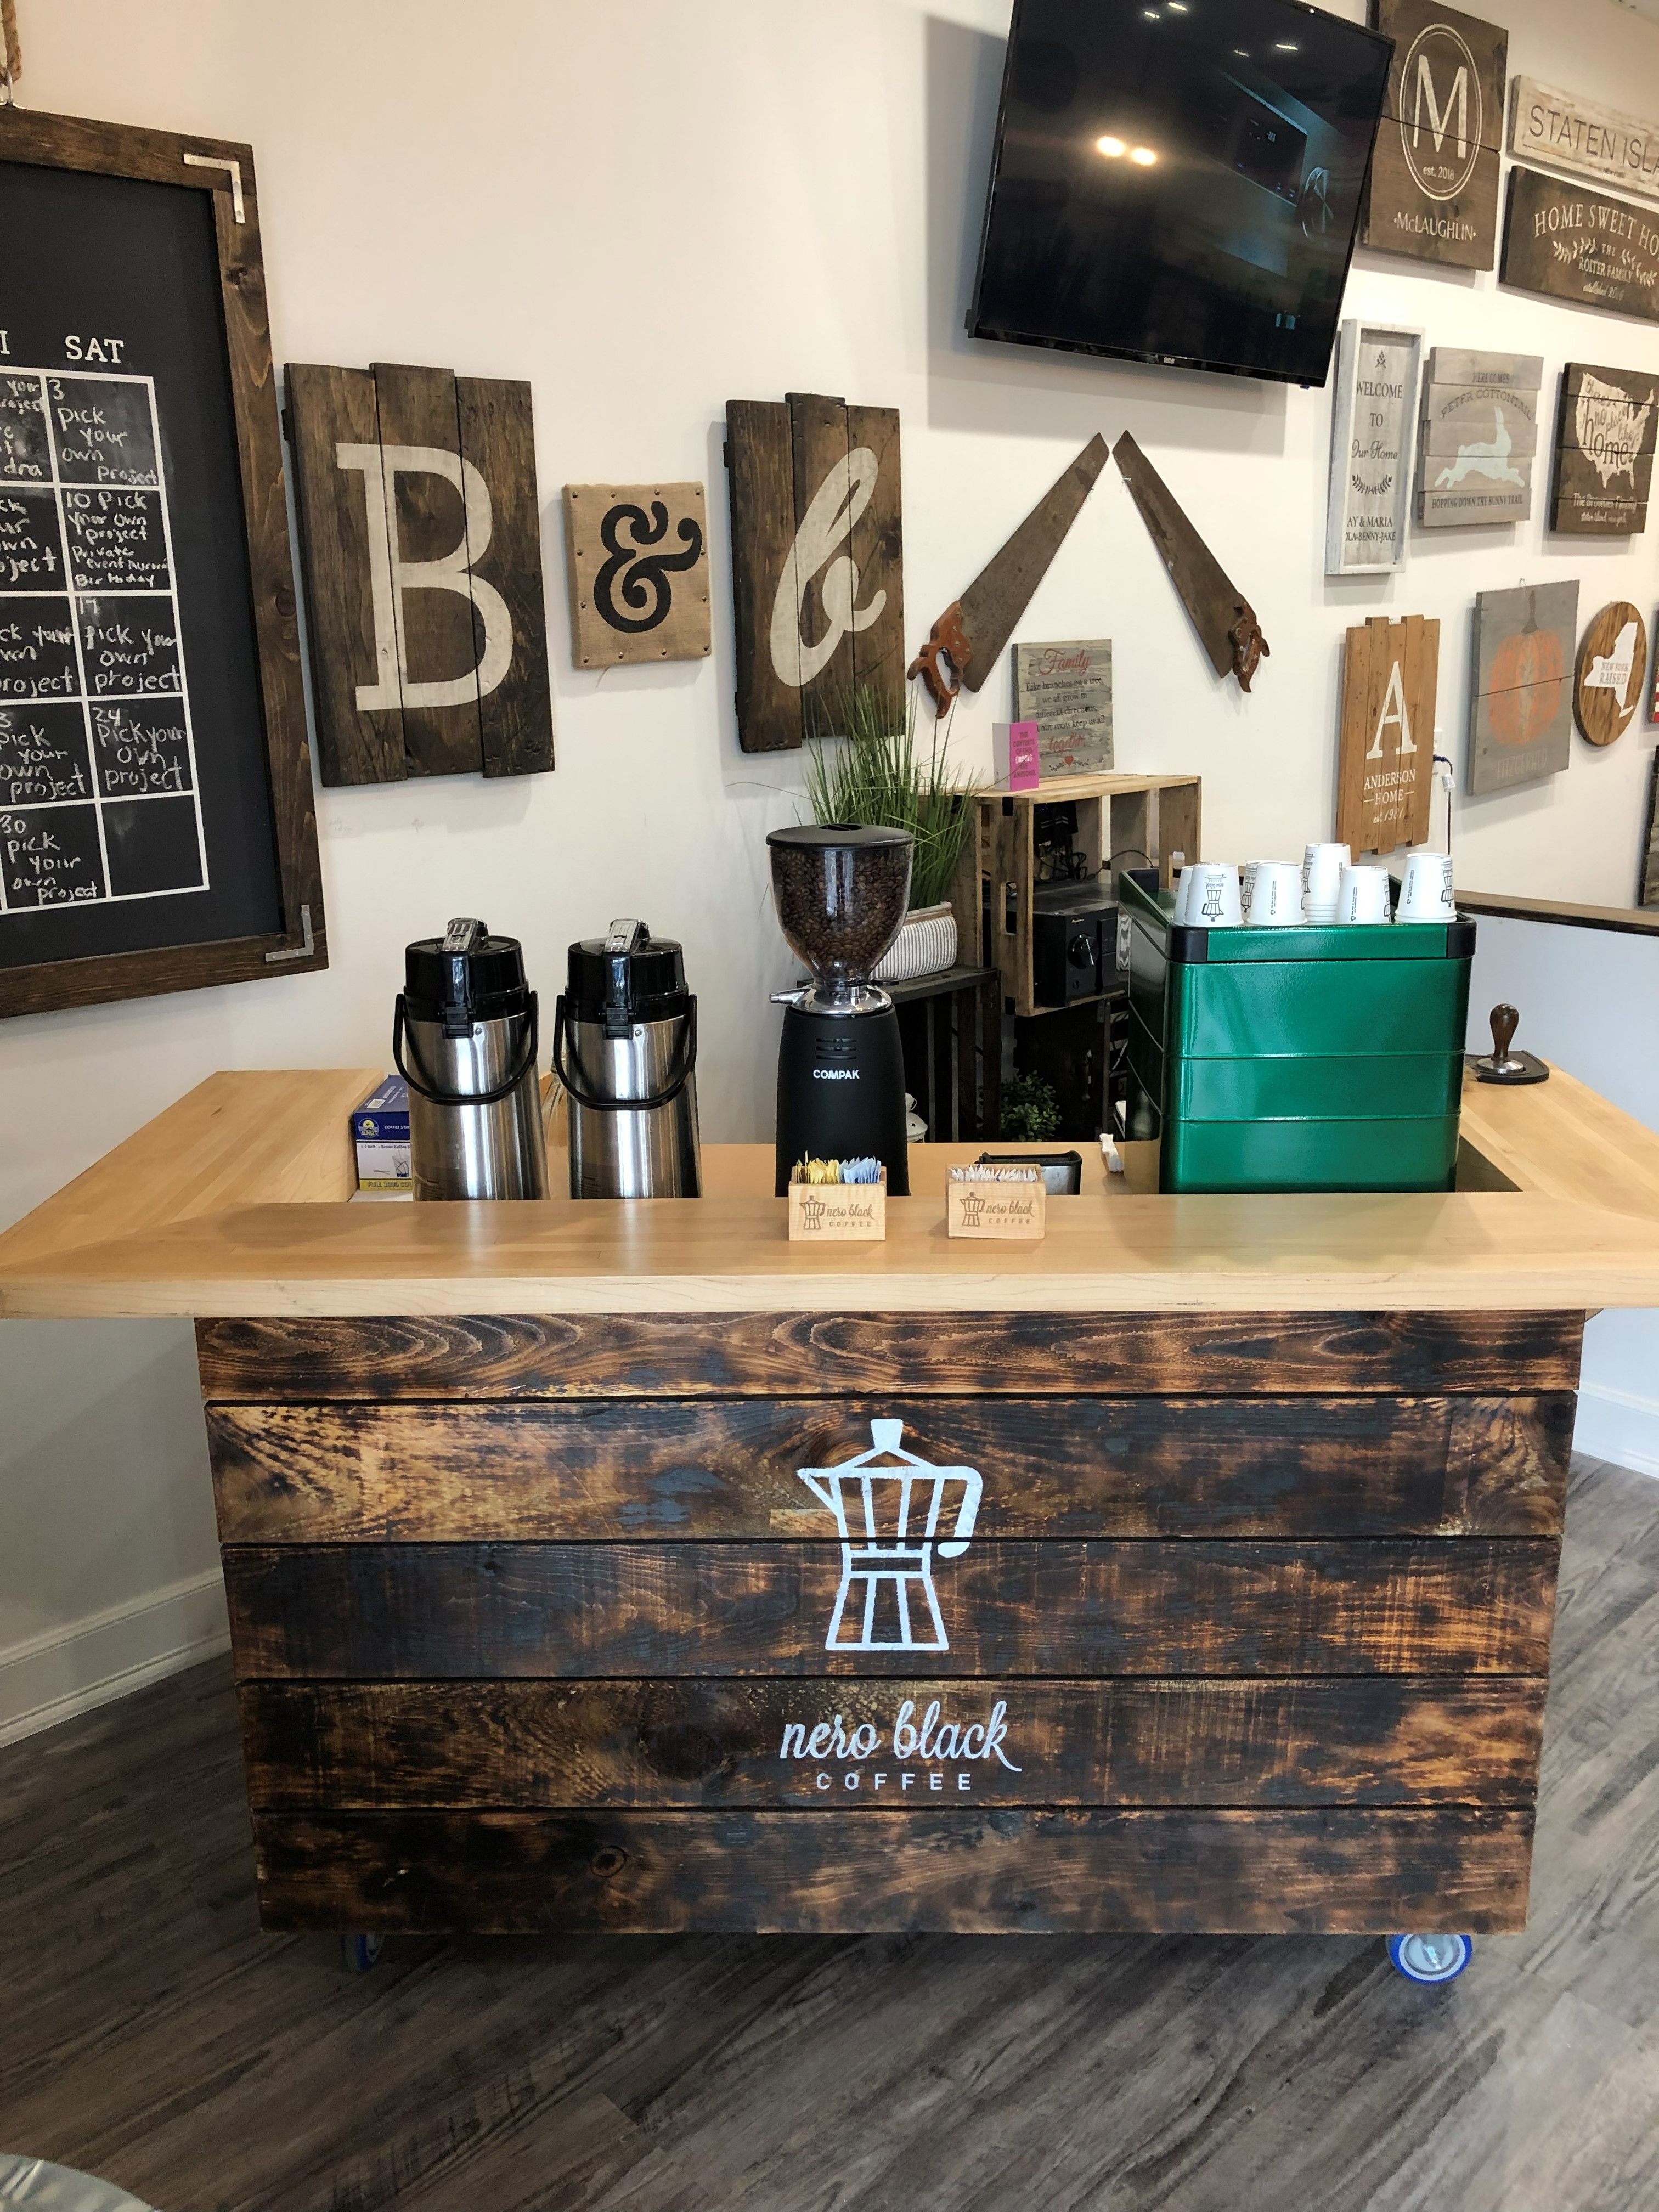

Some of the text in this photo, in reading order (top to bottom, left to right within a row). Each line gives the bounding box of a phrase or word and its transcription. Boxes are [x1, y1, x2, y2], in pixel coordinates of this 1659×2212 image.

[1413, 54, 1468, 159] M
[1530, 105, 1616, 161] STATEN
[1423, 166, 1455, 180] est. 2018
[1534, 204, 1584, 238] HOME
[1588, 205, 1637, 240] SWEET
[1602, 243, 1616, 257] THE
[1606, 264, 1633, 283] FAMILY
[65, 335, 124, 363] SAT
[49, 379, 65, 400] 3
[1356, 381, 1403, 399] WELCOME
[1370, 413, 1384, 427] TO
[79, 427, 128, 447] your
[61, 447, 104, 462] own
[1370, 441, 1398, 460] Home
[66, 491, 91, 509] 10
[1432, 498, 1458, 509] HOPPING
[1458, 497, 1476, 508] DOWN
[1477, 496, 1488, 506] THE
[1508, 494, 1523, 505] TRAIL
[1359, 516, 1365, 527] &
[1367, 516, 1392, 527] MARIA
[86, 526, 147, 546] project
[86, 556, 124, 569] event
[593, 500, 703, 634] &
[335, 442, 513, 712] B
[79, 596, 98, 614] 17
[99, 650, 148, 667] own
[1038, 648, 1091, 676] Family
[95, 664, 181, 695] project
[1026, 682, 1041, 692] Like
[1599, 672, 1627, 685] RAISED
[1063, 693, 1079, 703] grow
[92, 707, 121, 726] 24
[1367, 661, 1417, 759] A
[1054, 721, 1070, 730] roots
[1072, 719, 1087, 729] keep
[17, 748, 69, 764] your
[1364, 768, 1416, 791] ANDERSON
[1375, 789, 1403, 805] HOME
[813, 1069, 860, 1080] COMPAK
[827, 1203, 875, 1220] nero black
[986, 1200, 1035, 1217] nero black
[780, 1700, 1023, 1772] nero black
[816, 1773, 971, 1790] COFFEE
